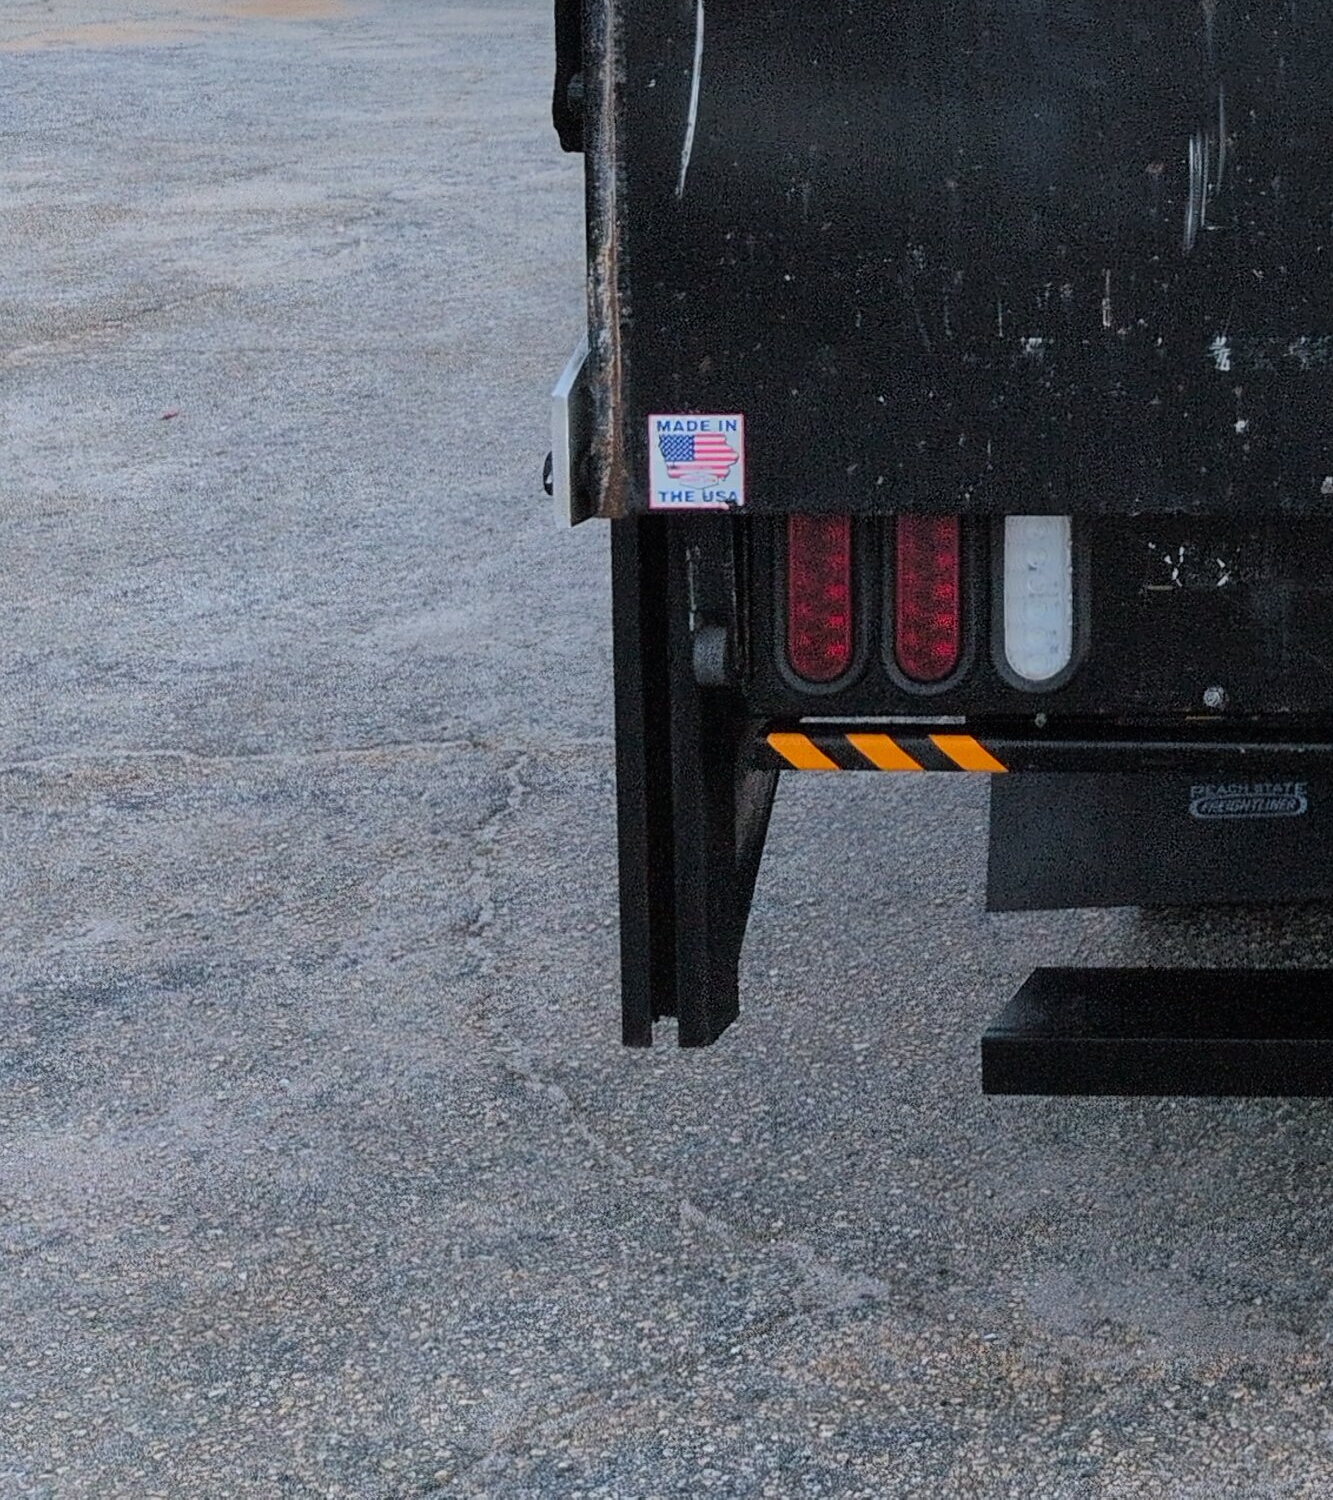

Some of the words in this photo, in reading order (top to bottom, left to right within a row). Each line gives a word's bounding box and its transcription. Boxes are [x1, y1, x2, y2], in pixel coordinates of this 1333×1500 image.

[656, 420, 710, 432] MADE
[718, 420, 737, 432] IN
[658, 491, 695, 503] THE
[702, 490, 738, 503] USA
[1253, 780, 1308, 797] STATE
